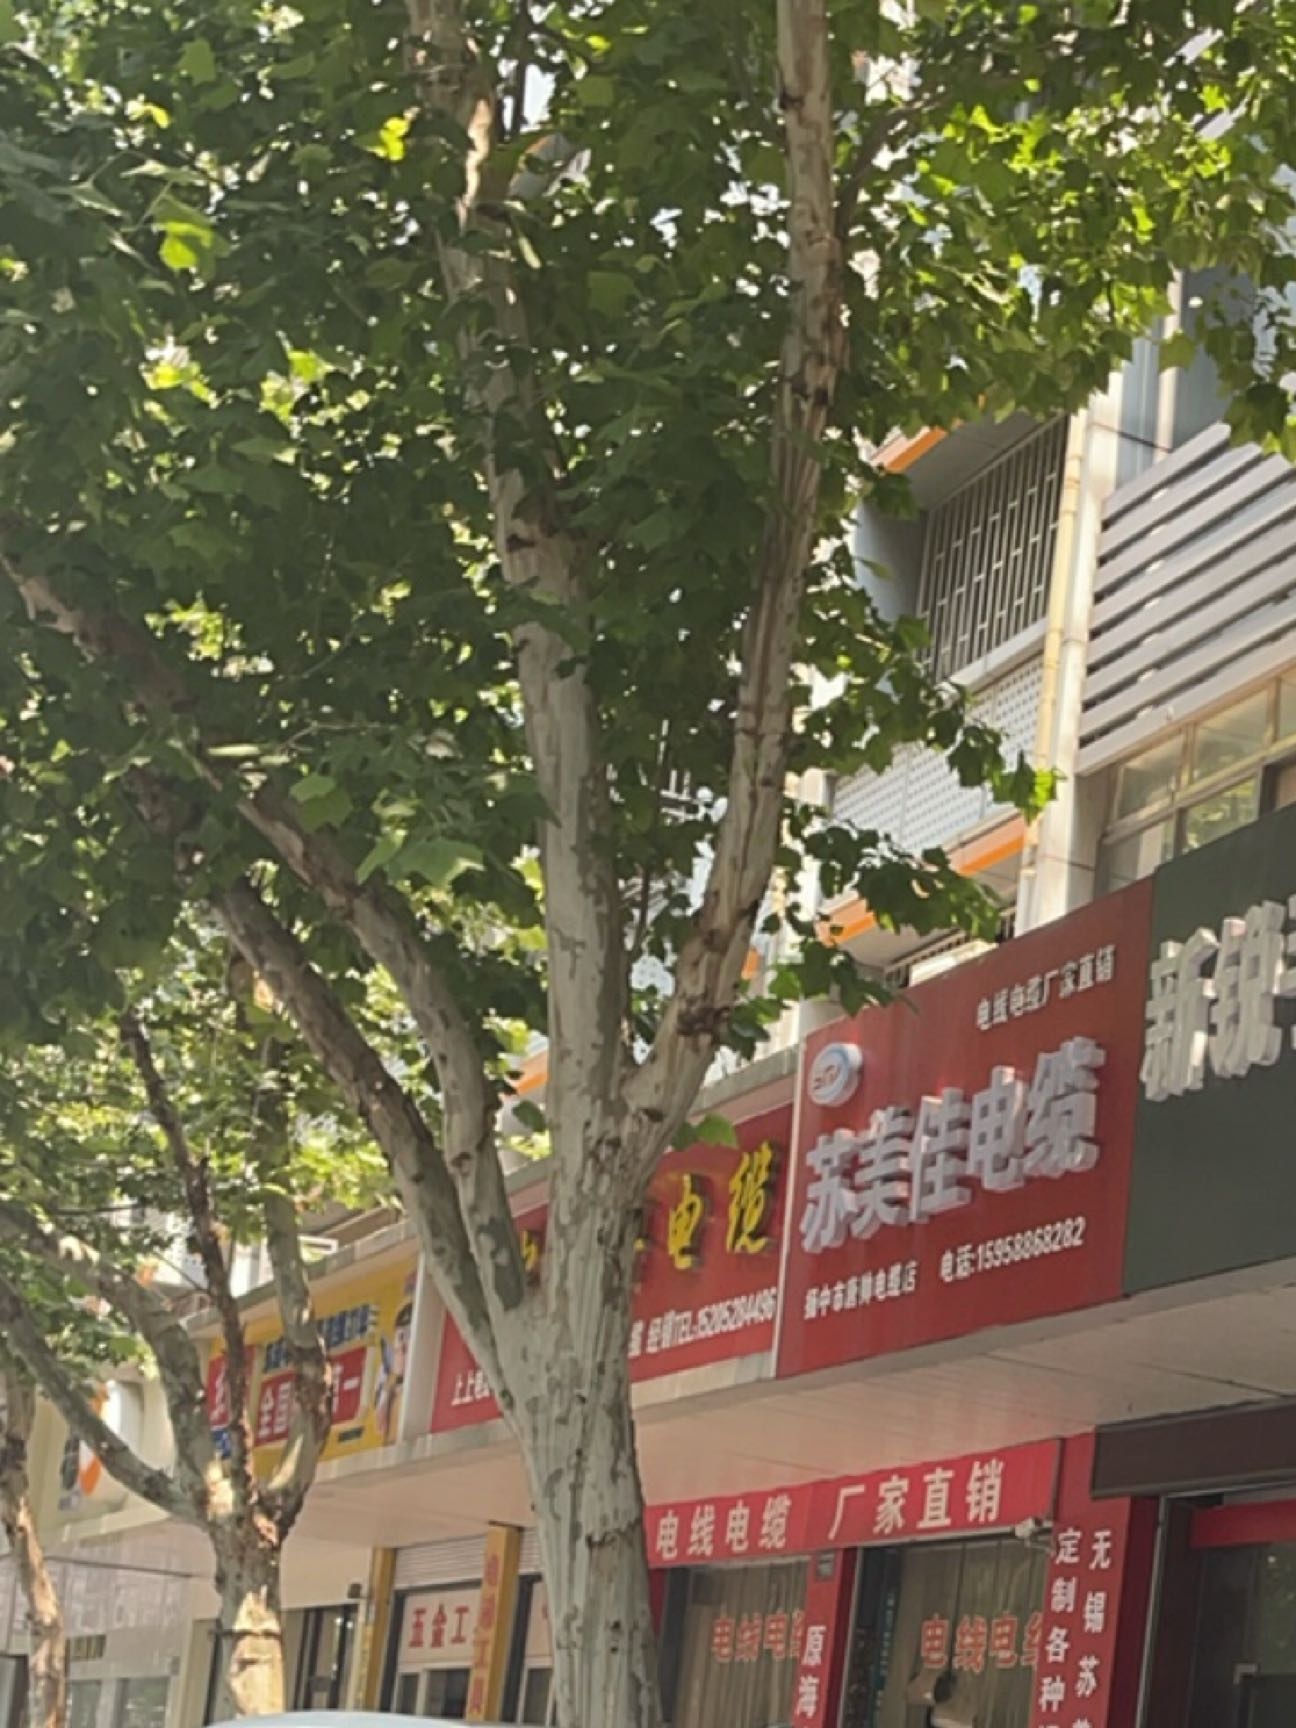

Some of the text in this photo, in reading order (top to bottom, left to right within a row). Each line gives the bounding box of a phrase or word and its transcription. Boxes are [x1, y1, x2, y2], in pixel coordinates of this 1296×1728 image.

[799, 1036, 1106, 1254] 苏美佳电缆
[667, 1140, 773, 1270] 电缆
[656, 1458, 1004, 1560] 电线电缆 厂家直销
[712, 1610, 802, 1663] 电线电
